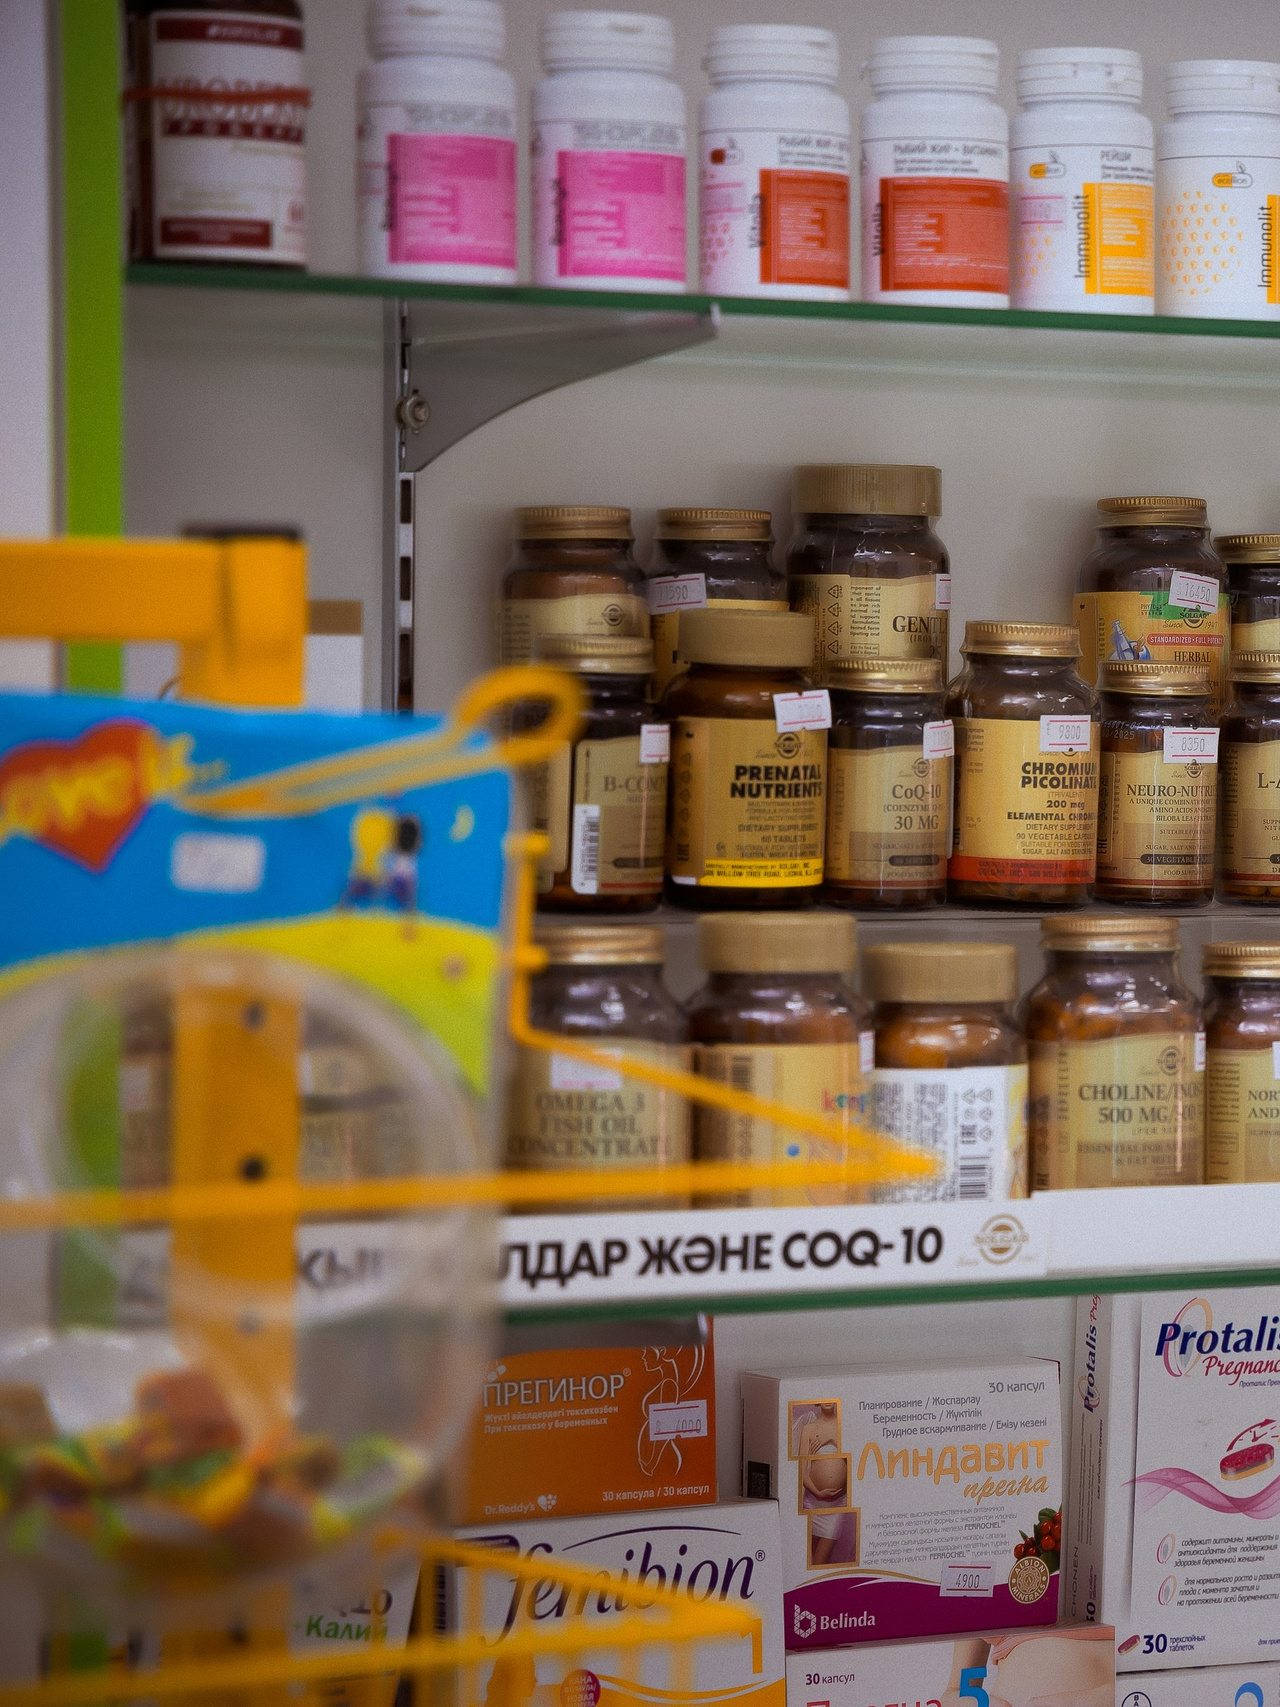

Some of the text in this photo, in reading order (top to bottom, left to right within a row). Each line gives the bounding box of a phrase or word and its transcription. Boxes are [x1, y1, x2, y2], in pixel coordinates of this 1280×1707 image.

[1258, 205, 1273, 288] Immunolit
[1184, 584, 1211, 601] 16450
[1150, 636, 1192, 645] STANDARDIZED
[1174, 652, 1211, 663] HERBAL
[1059, 725, 1081, 739] 9800
[1181, 737, 1205, 752] 8350
[735, 765, 821, 781] PRENATAL
[1022, 762, 1096, 776] CHROMIUM
[1021, 776, 1096, 789] PICOLINATE
[730, 783, 821, 798] NUTRIENTS
[892, 785, 941, 799] CoQ-10
[1046, 800, 1085, 810] 200 mcg
[894, 815, 938, 830] 30 MG
[1007, 812, 1063, 820] ELEMENTAL
[1028, 832, 1071, 841] VEGETABLE
[536, 1094, 620, 1111] OMEGA
[1248, 1107, 1278, 1118] AND
[540, 1115, 641, 1134] FISH OIL
[639, 1233, 771, 1273] ЖӘНЕ
[783, 1227, 943, 1269] COQ-10
[1084, 1324, 1097, 1412] Protalis
[482, 1374, 624, 1407] ПРЕГИНОР
[989, 1382, 1045, 1393] 30 капсул
[859, 1399, 922, 1410] Планирование
[873, 1409, 982, 1424] Беременность Жүктілік
[883, 1422, 986, 1438] Грудное вскармливание
[857, 1440, 1050, 1484] Линдавит
[602, 1484, 709, 1501] 30 капсула 30 капсул
[964, 1476, 1049, 1505] прегна
[485, 1502, 536, 1515] Dr.Reddy's
[1015, 1559, 1045, 1574] ALBION
[956, 1573, 980, 1589] 4900
[1010, 1585, 1045, 1602] MINERALS
[820, 1612, 875, 1629] Belinda
[1143, 1634, 1167, 1654] 30
[1170, 1635, 1205, 1644] трехслойных
[806, 1672, 855, 1685] 30 капсул
